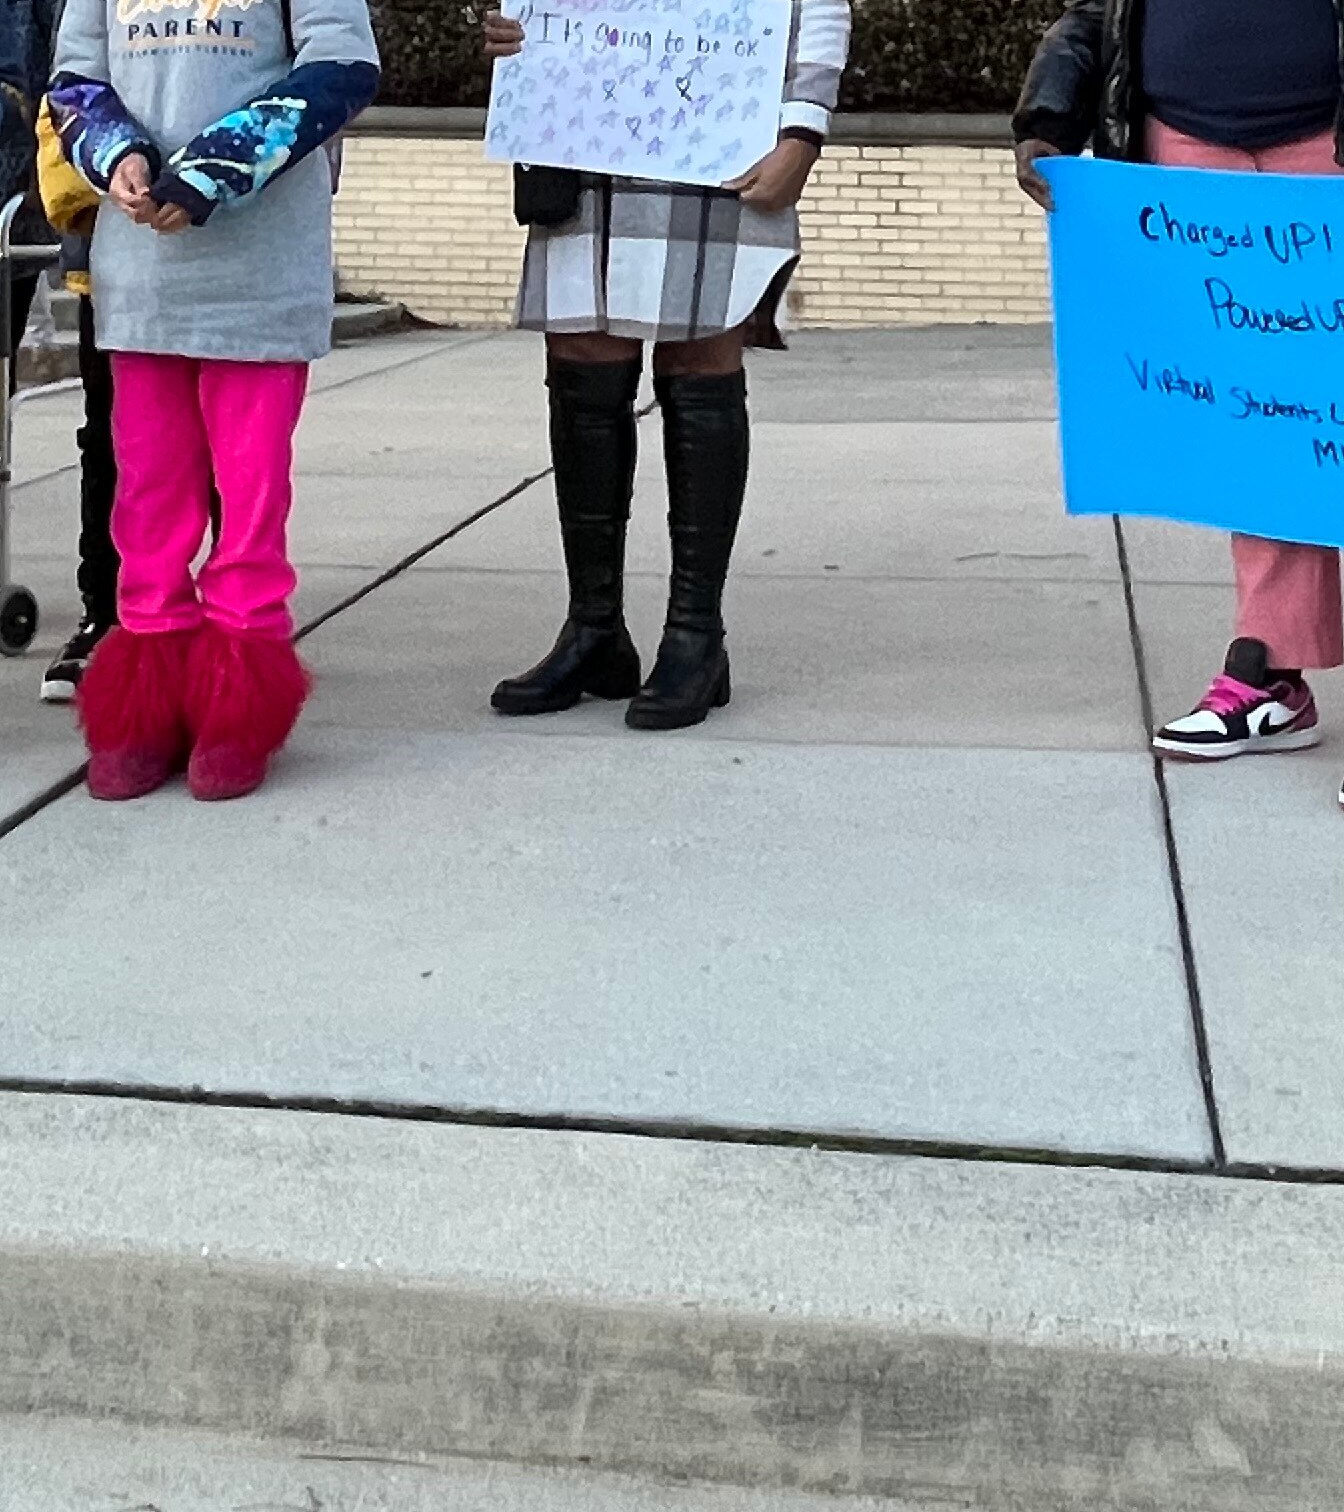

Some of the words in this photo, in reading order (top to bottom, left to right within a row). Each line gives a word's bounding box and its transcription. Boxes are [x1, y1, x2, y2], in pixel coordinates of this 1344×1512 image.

[128, 18, 244, 41] PARENT
[590, 22, 652, 66] going
[664, 29, 685, 54] to
[697, 34, 722, 55] be
[1138, 201, 1255, 257] Charged
[1203, 276, 1316, 335] Powered
